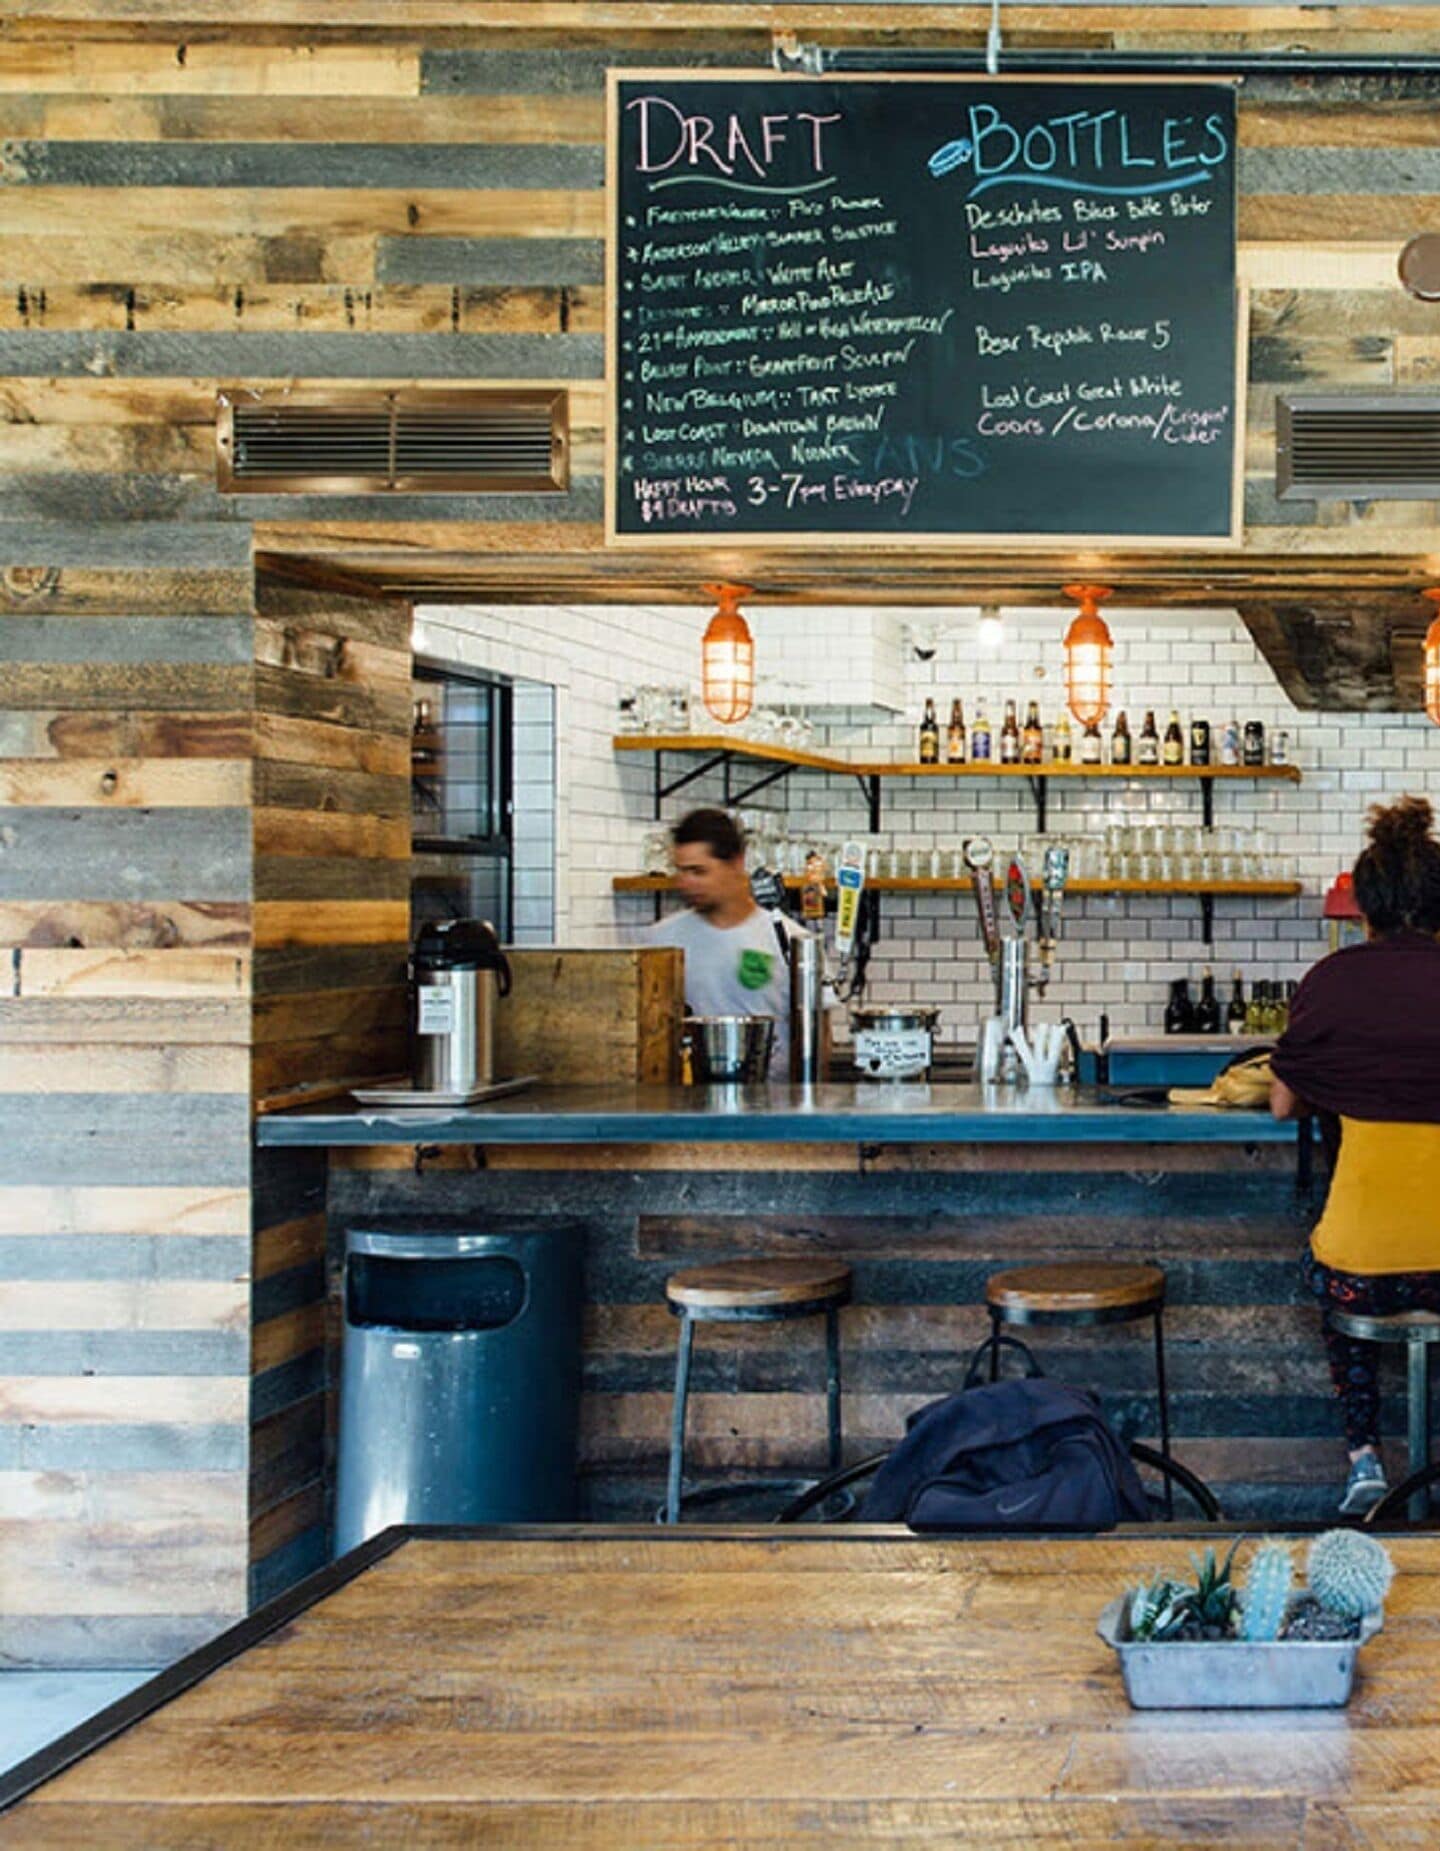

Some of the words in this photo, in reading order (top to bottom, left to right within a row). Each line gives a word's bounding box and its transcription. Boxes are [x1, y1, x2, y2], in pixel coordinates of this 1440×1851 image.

[625, 97, 842, 177] DRAFT
[968, 105, 1228, 176] BOTTLES
[817, 256, 856, 282] ALE
[1060, 259, 1107, 283] IPA
[975, 325, 1021, 356] Bear
[1151, 320, 1170, 351] 5
[977, 412, 1044, 436] Coors
